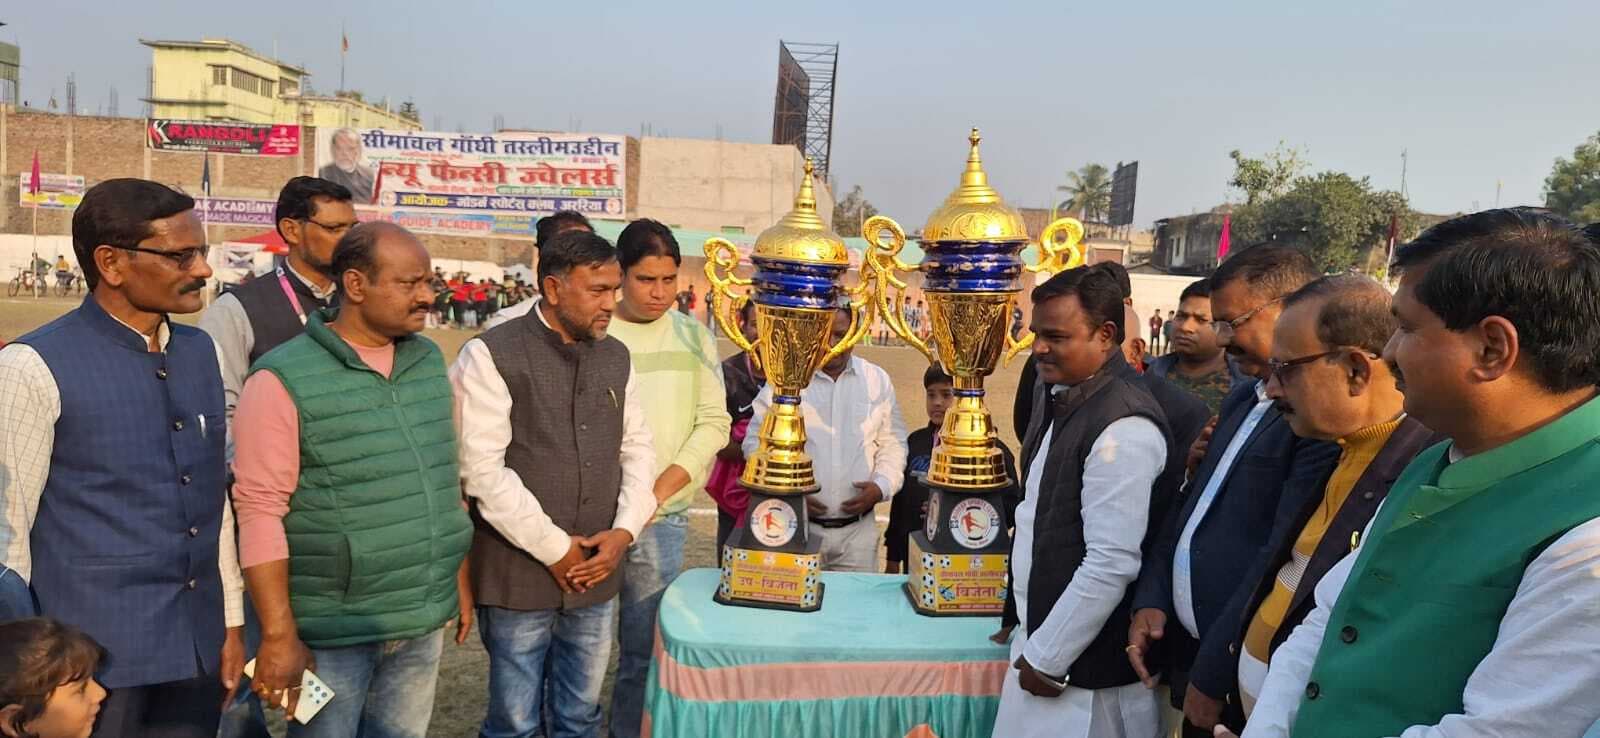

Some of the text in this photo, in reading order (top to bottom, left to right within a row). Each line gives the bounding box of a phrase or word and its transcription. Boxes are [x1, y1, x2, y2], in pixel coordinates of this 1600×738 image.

[361, 130, 444, 152] सीमांचल
[213, 201, 273, 213] ACADEMY
[761, 576, 799, 591] विजेता
[956, 583, 997, 598] विजेता
